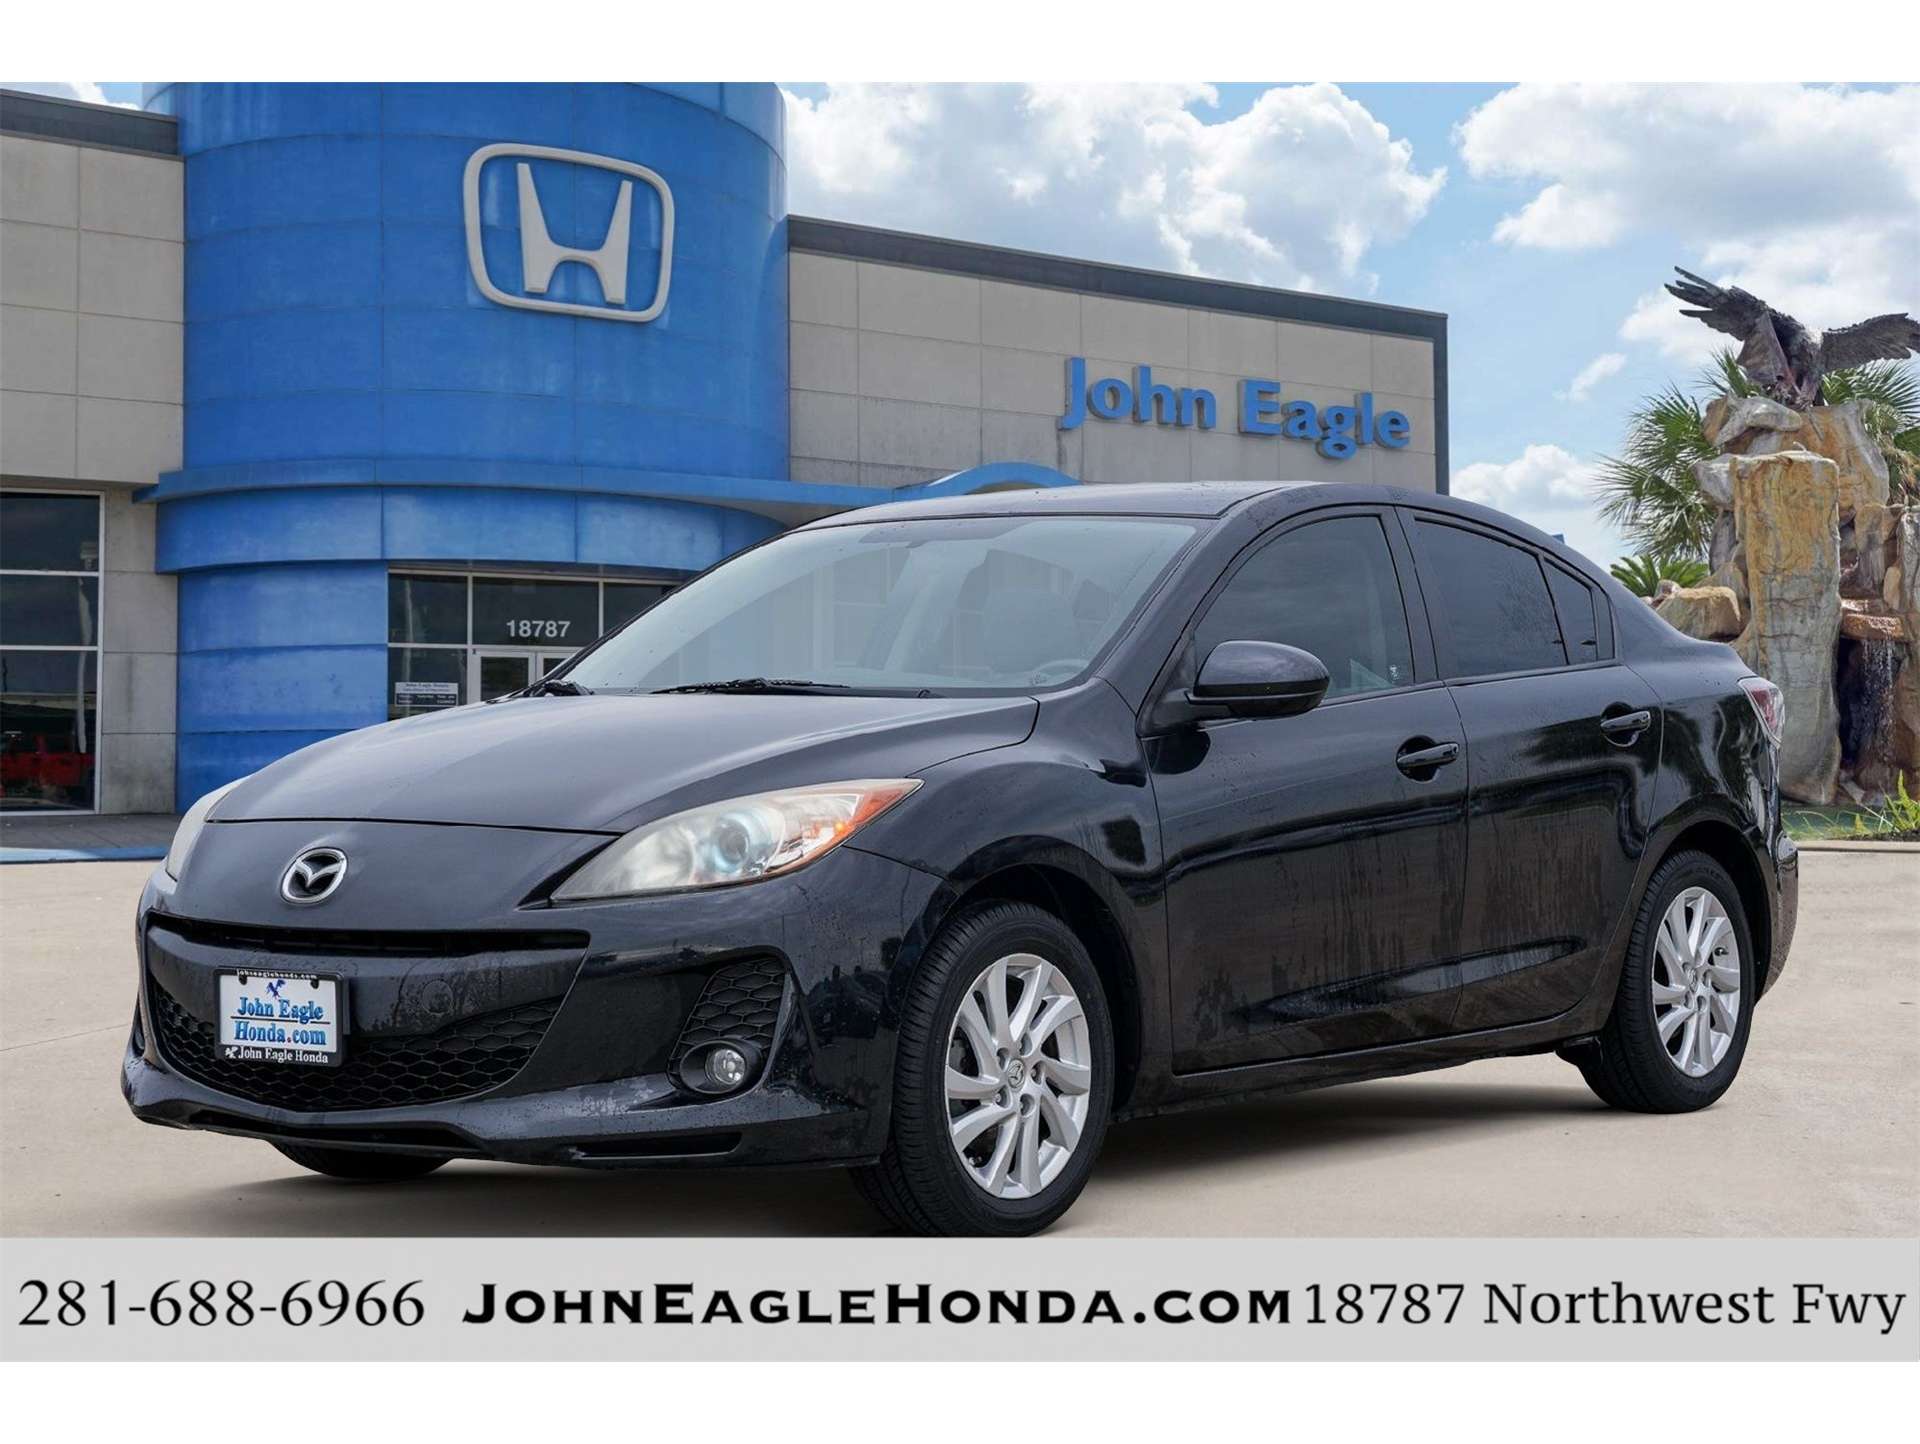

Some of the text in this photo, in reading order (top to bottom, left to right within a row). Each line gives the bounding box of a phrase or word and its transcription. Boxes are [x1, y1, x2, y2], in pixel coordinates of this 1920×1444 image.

[1056, 356, 1411, 459] John Eagle
[506, 619, 572, 638] 18787
[238, 997, 323, 1024] John Eagle
[235, 1021, 326, 1045] Honda.com
[238, 1047, 328, 1063] John Eagle Honda
